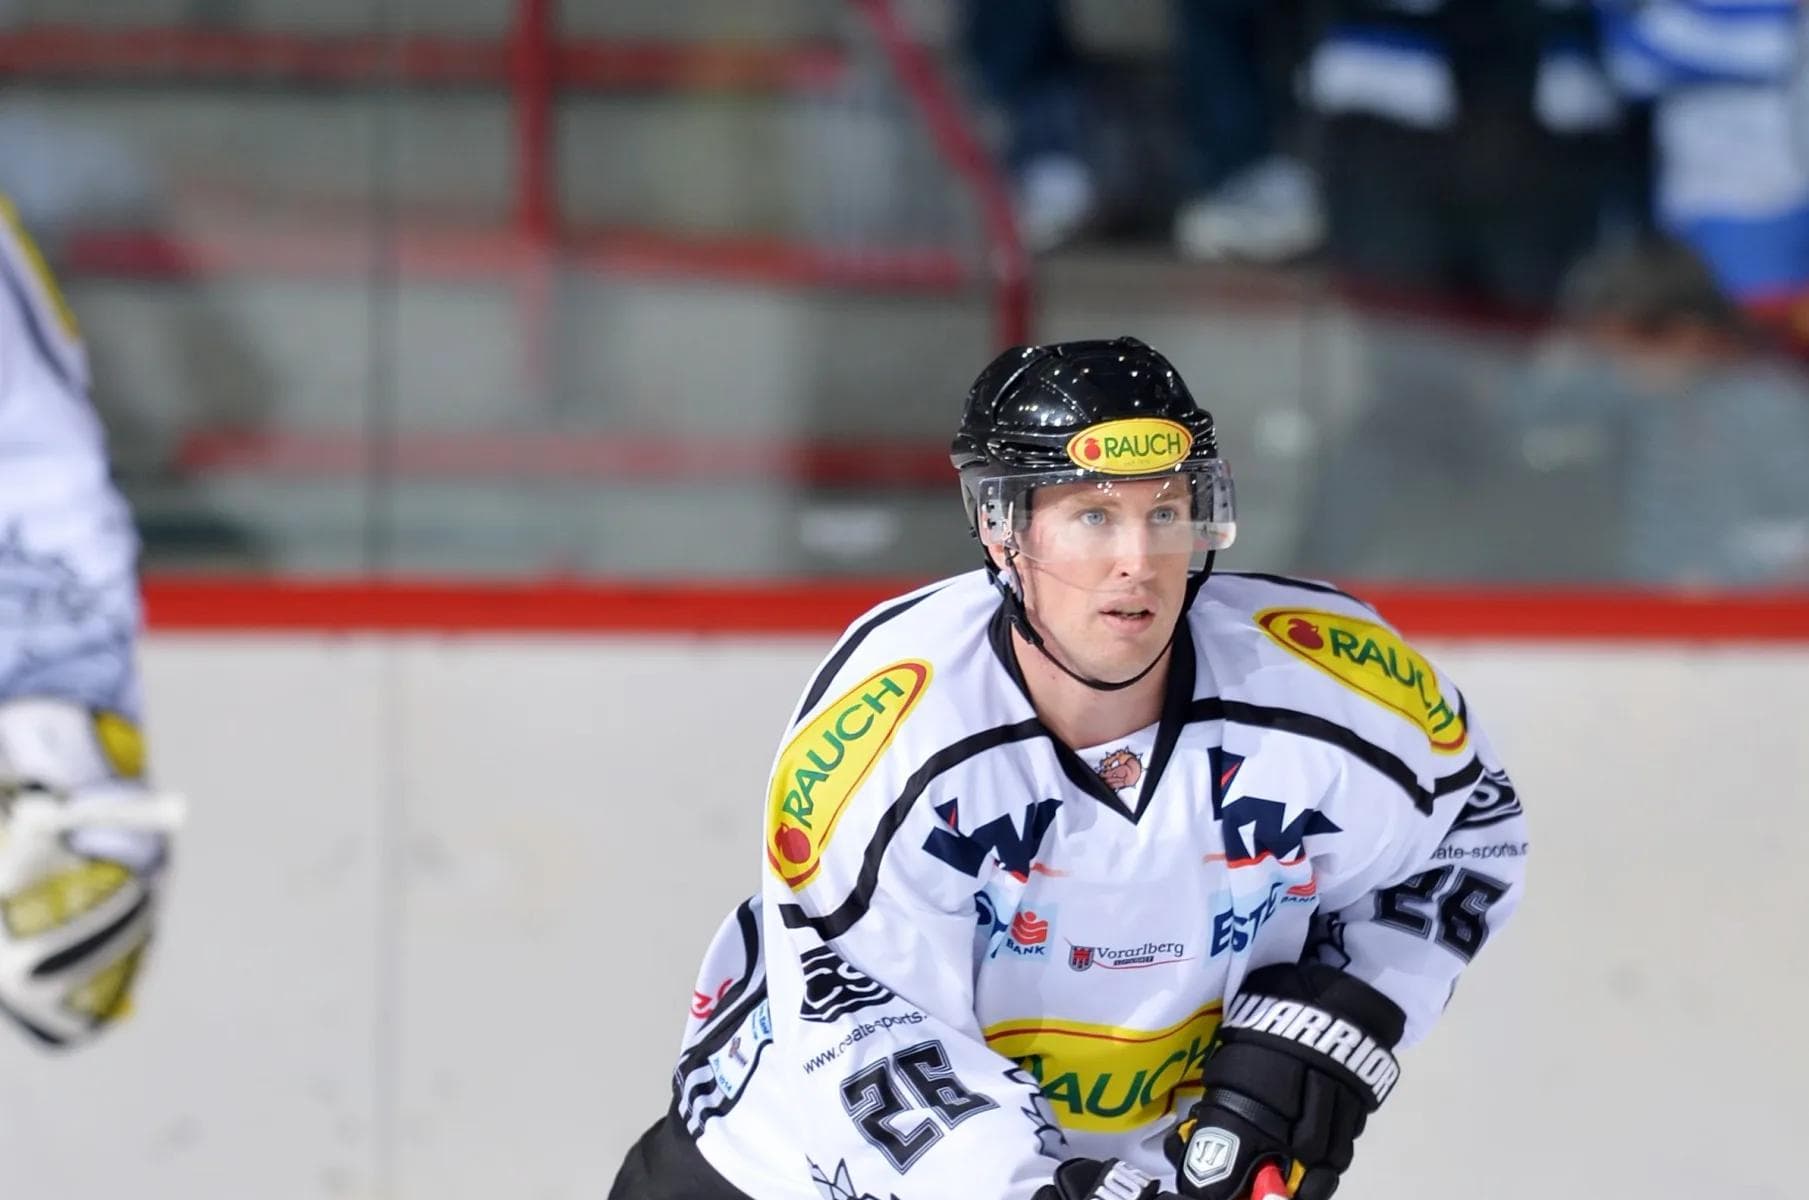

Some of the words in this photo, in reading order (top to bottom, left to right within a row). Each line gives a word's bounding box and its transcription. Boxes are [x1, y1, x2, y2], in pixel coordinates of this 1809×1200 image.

[1103, 432, 1182, 459] RAUCH
[781, 676, 906, 830] RAUCH
[1006, 938, 1046, 956] BANK
[1095, 941, 1185, 960] Vorarlberg
[1371, 863, 1515, 966] 26
[1222, 993, 1399, 1104] WARRIOR
[839, 1039, 1002, 1176] 26
